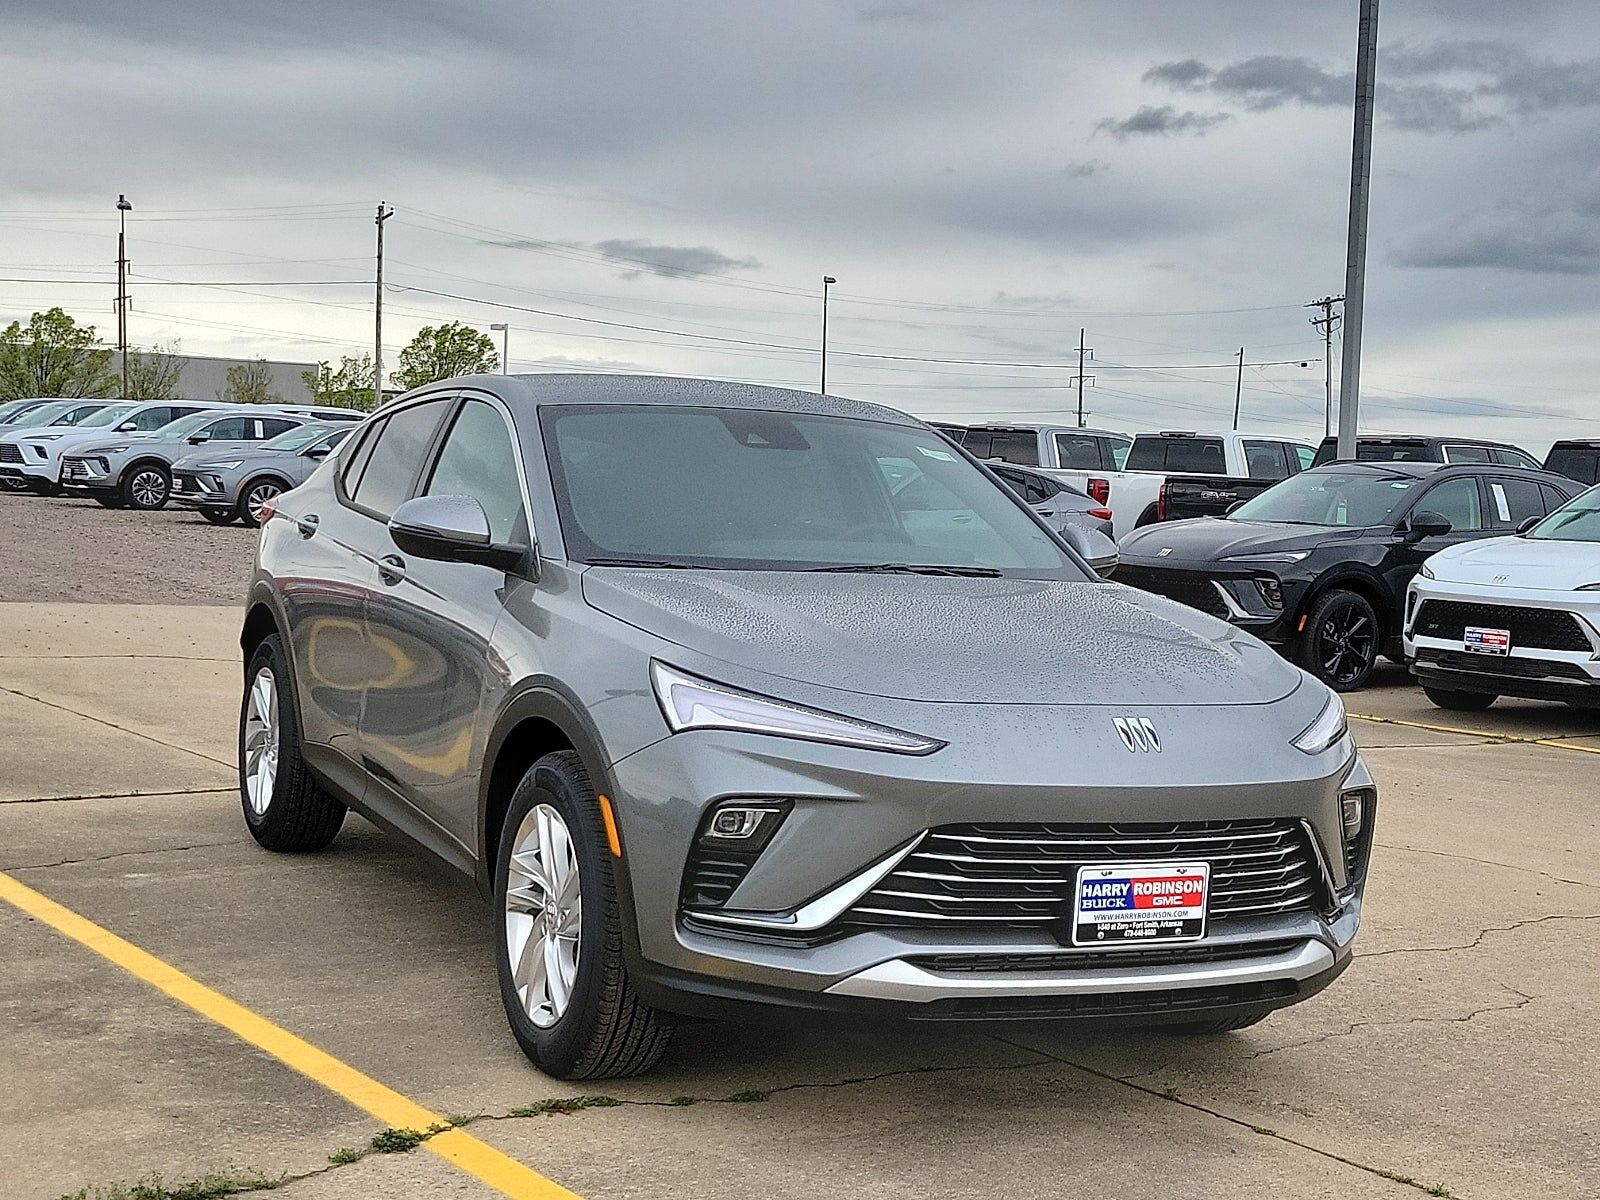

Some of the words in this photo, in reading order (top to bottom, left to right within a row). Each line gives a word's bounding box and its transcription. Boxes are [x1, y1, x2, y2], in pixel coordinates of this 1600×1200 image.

[1082, 883, 1130, 898] HARRY
[1134, 880, 1202, 896] ROBINSON
[1081, 897, 1127, 909] BUICK
[1152, 896, 1183, 906] GMC
[1093, 910, 1188, 921] WWW.HARRYROBINSON.COM
